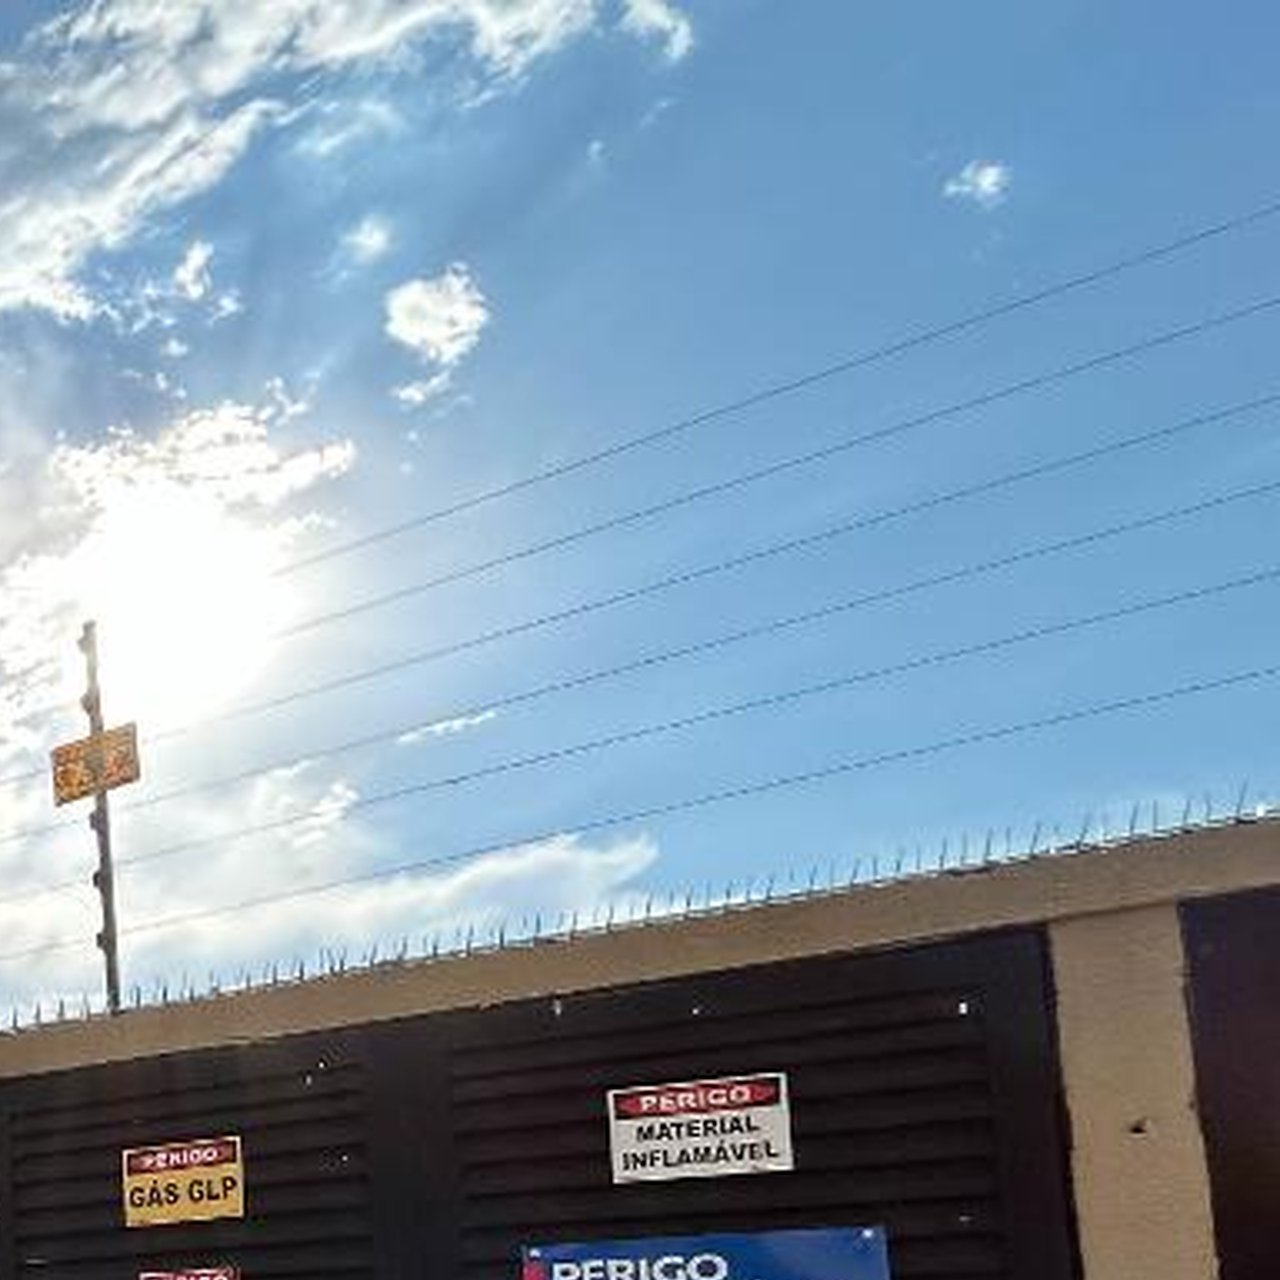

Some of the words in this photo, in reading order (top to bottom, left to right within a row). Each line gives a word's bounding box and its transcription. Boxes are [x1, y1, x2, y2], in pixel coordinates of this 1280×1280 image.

[640, 1085, 752, 1112] PERIGO
[636, 1115, 760, 1142] MATERIAL
[622, 1140, 780, 1170] INFLAMÁVEL
[189, 1176, 238, 1203] GLP
